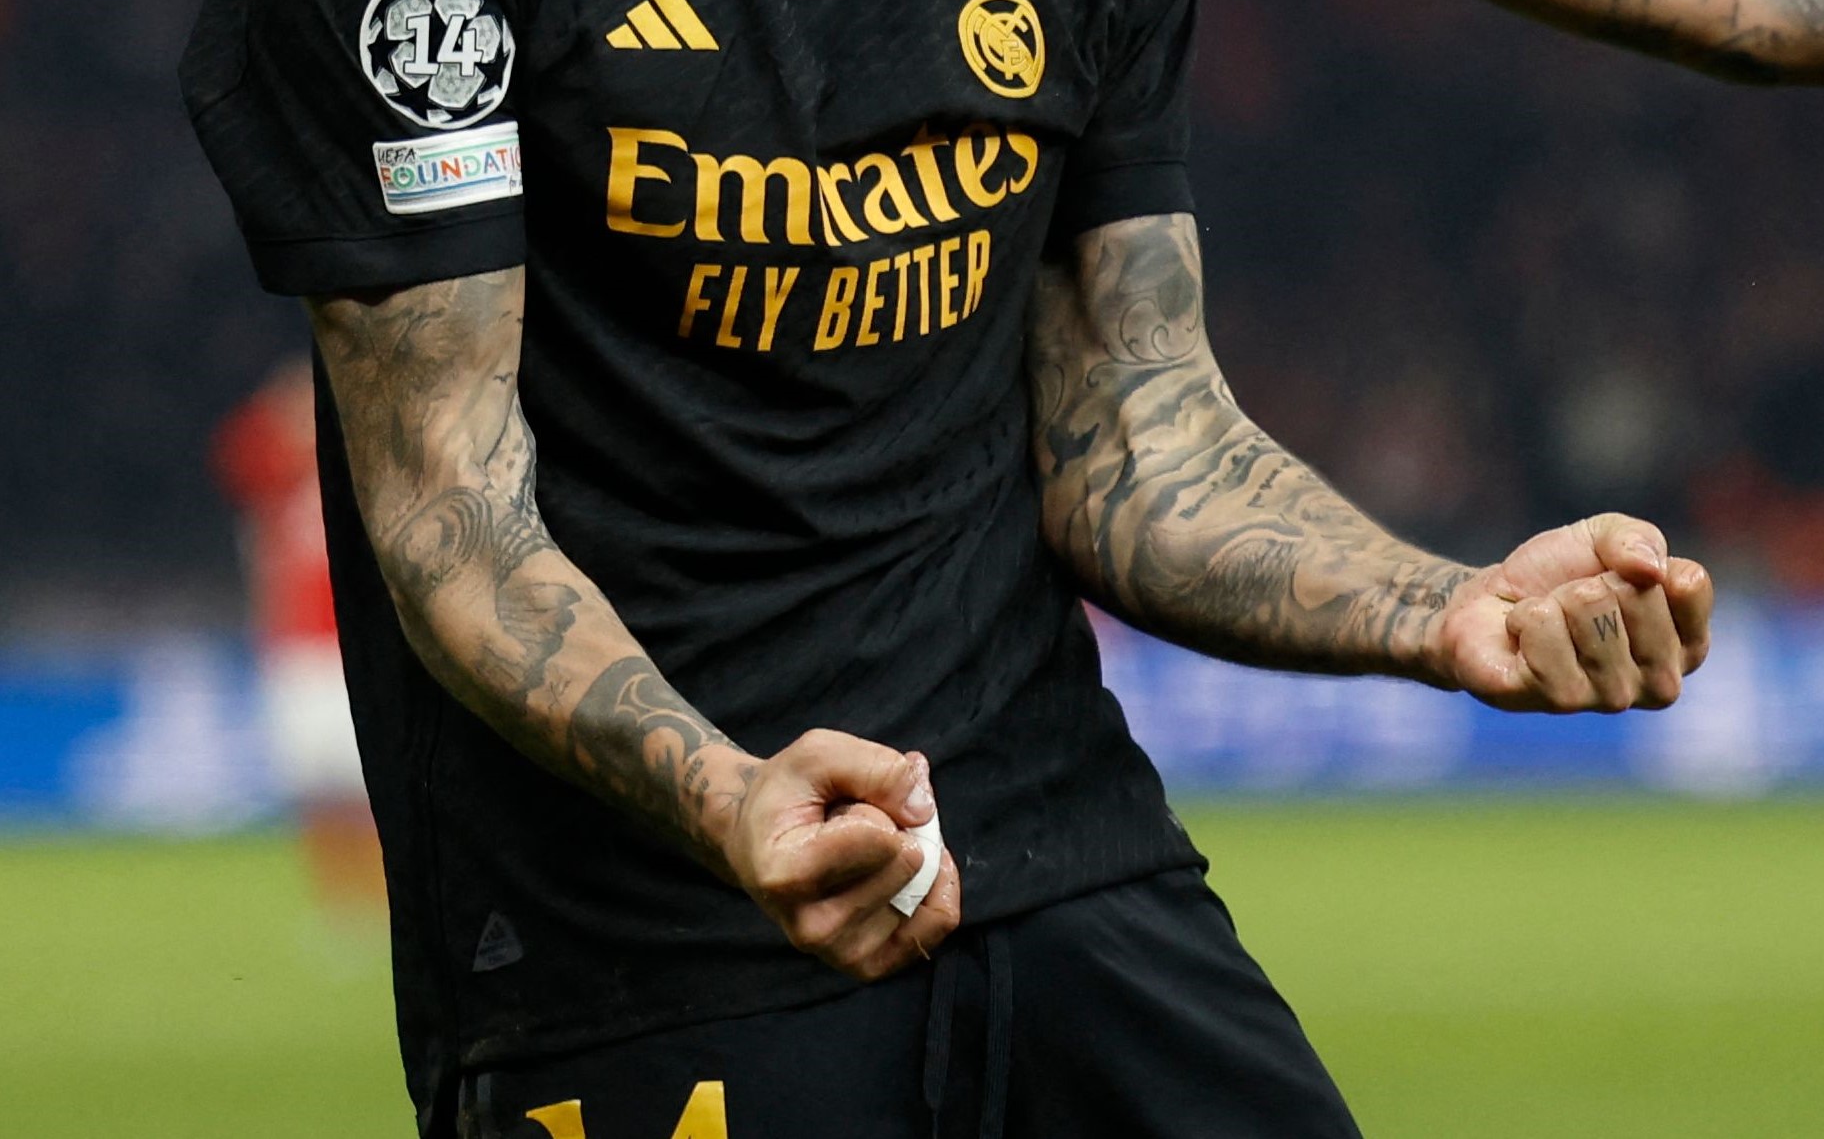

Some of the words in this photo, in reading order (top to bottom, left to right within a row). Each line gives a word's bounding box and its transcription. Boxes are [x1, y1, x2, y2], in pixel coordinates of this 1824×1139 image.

[404, 14, 486, 77] 14
[377, 147, 416, 163] UEFA
[679, 264, 801, 352] FLY
[814, 229, 993, 352] BETTER
